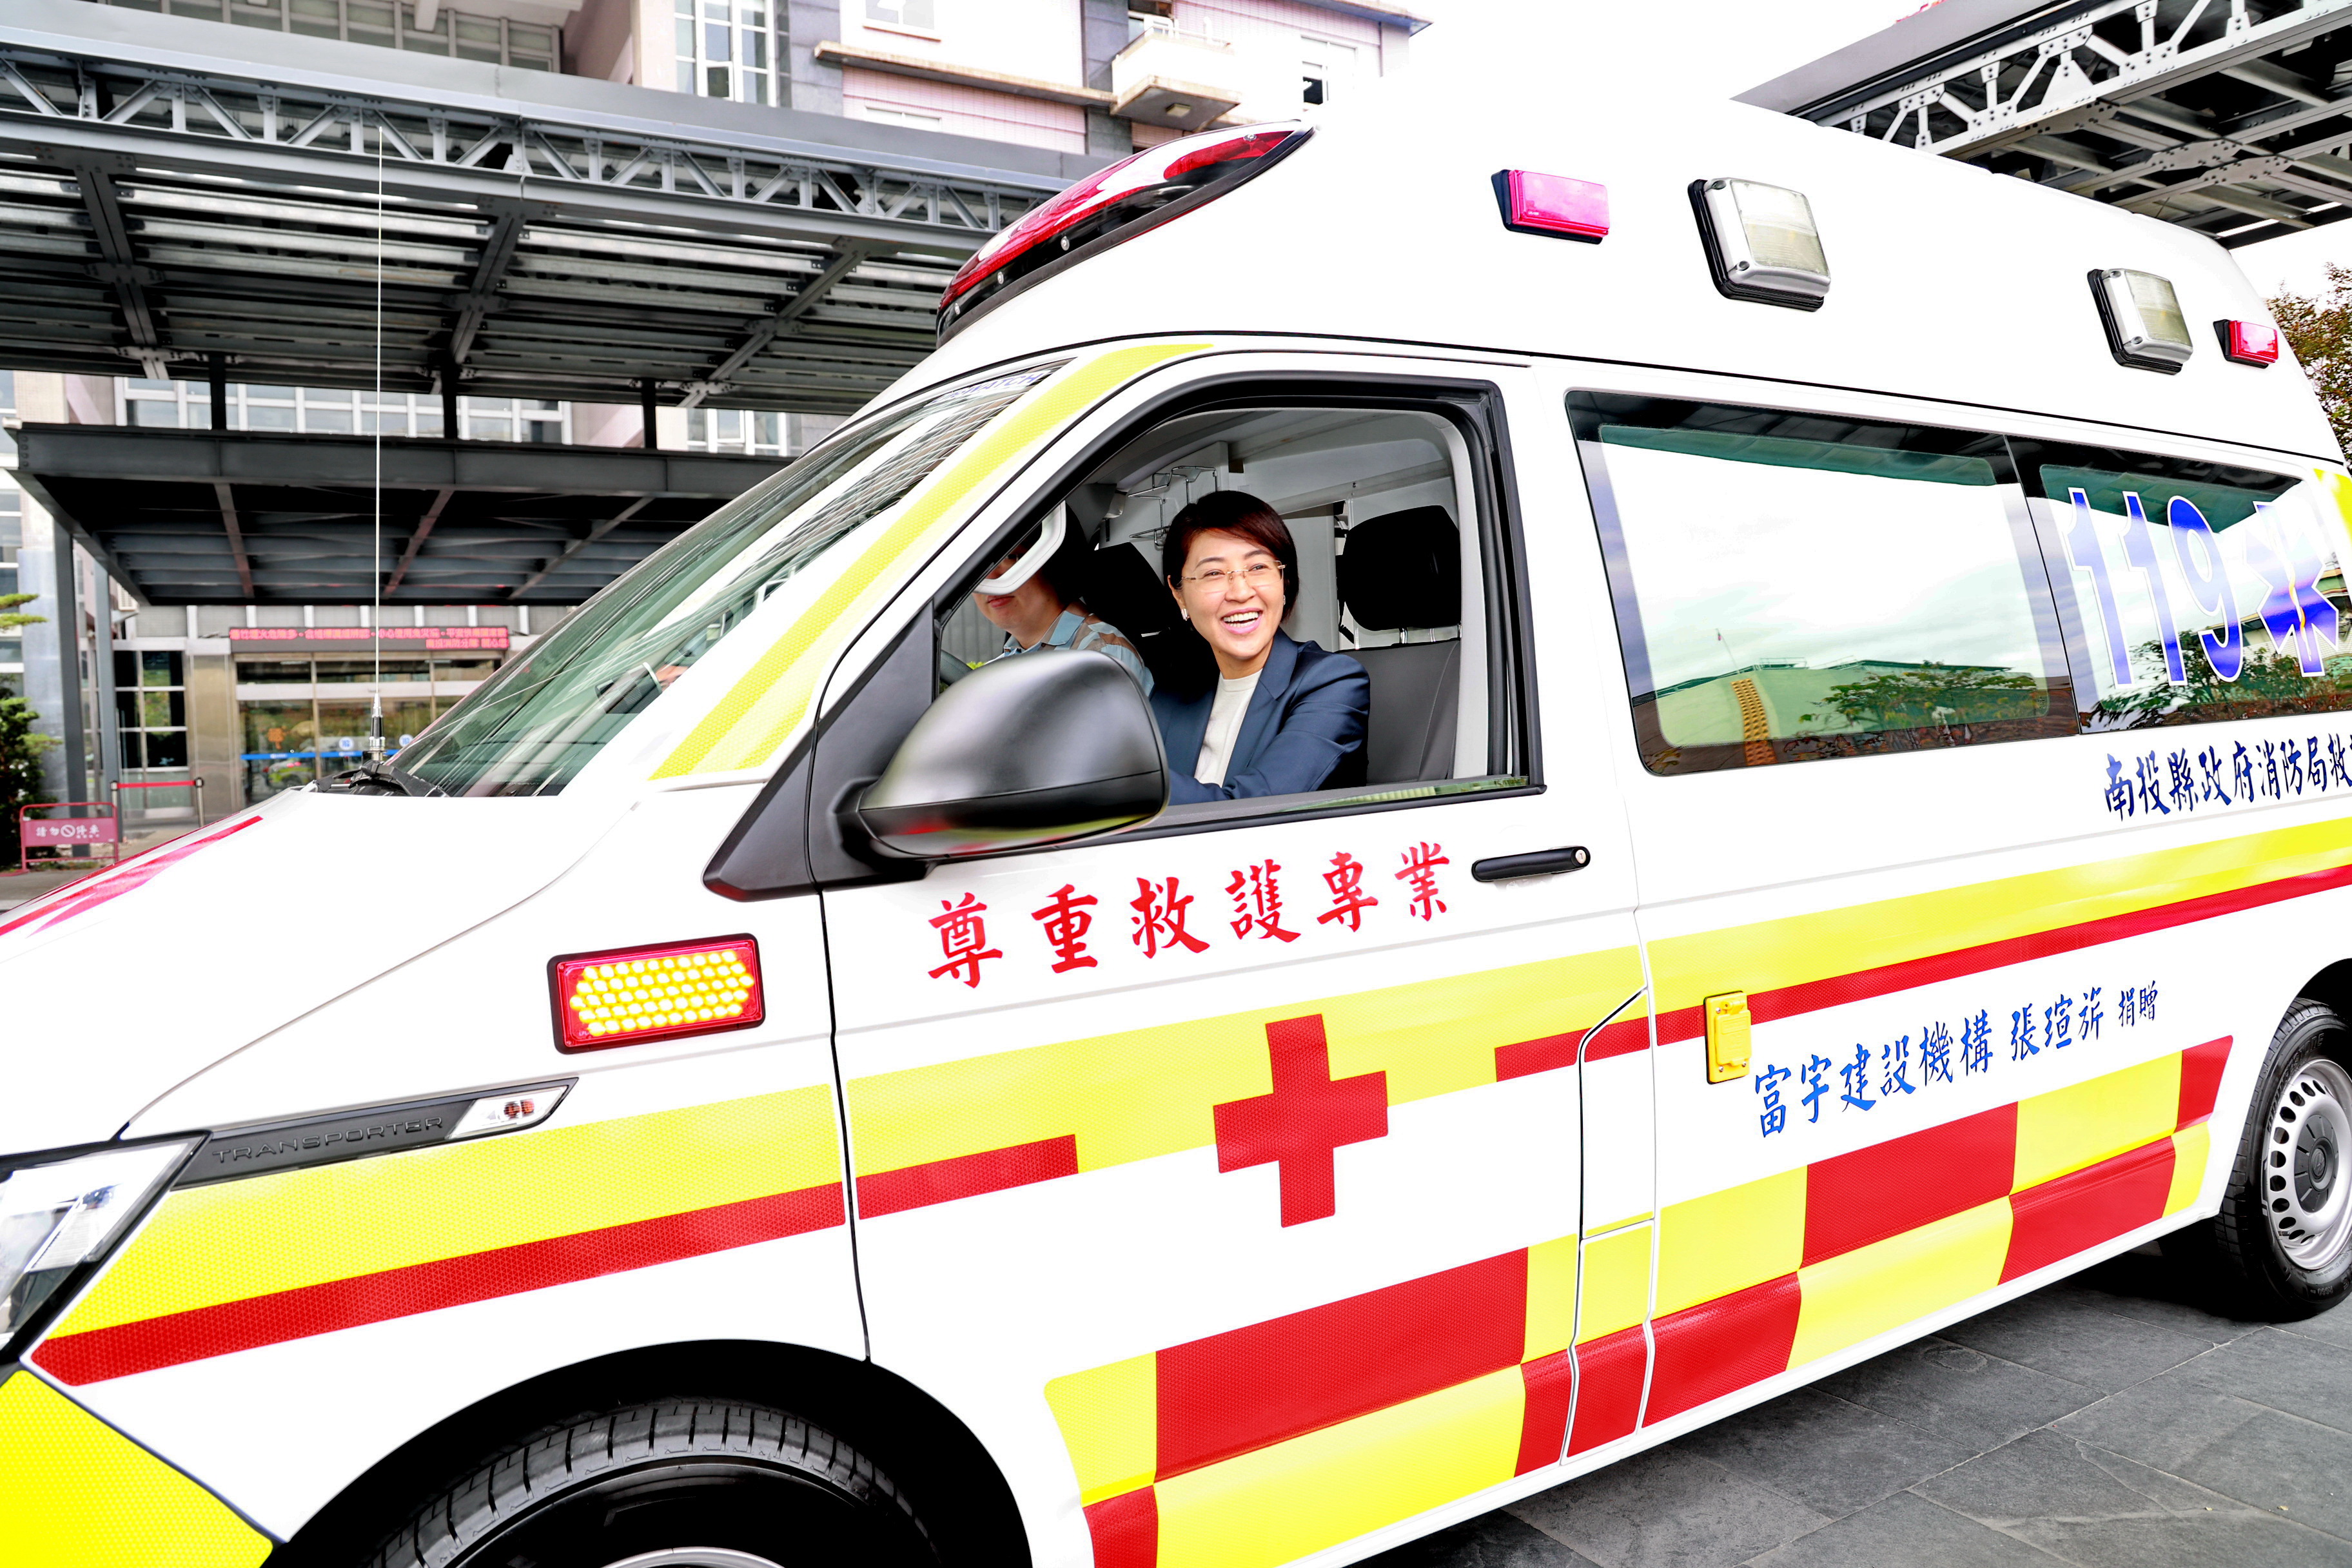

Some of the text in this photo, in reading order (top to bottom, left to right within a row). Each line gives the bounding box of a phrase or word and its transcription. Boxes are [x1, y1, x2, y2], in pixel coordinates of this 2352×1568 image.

[2062, 487, 2244, 689] 119
[2104, 732, 2352, 822] 南投縣政府消防局救
[928, 841, 1450, 989] 尊重救護專業
[1755, 1008, 1994, 1138] 富宇建設機構
[2119, 980, 2159, 1027] 捐贈
[213, 1116, 443, 1163] TRANSPORTER
